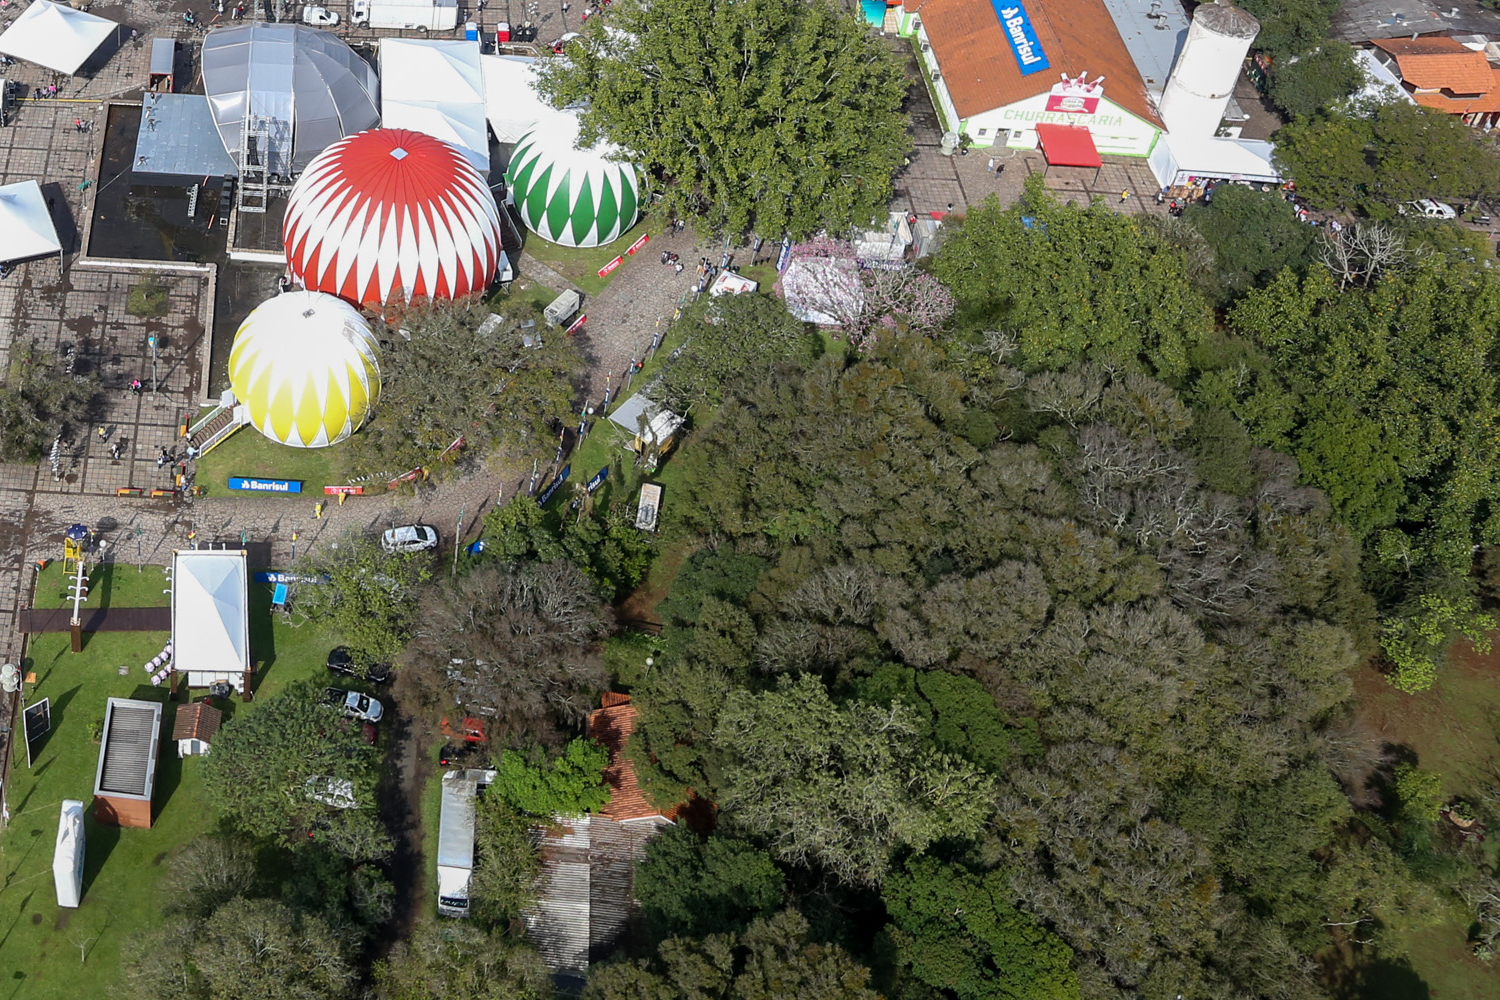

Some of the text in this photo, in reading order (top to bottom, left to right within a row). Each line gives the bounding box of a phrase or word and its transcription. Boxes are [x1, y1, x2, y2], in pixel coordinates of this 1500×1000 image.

[1006, 16, 1041, 65] Banrisul
[1004, 109, 1123, 127] CHURRASCARIA
[250, 481, 289, 491] Banrisul
